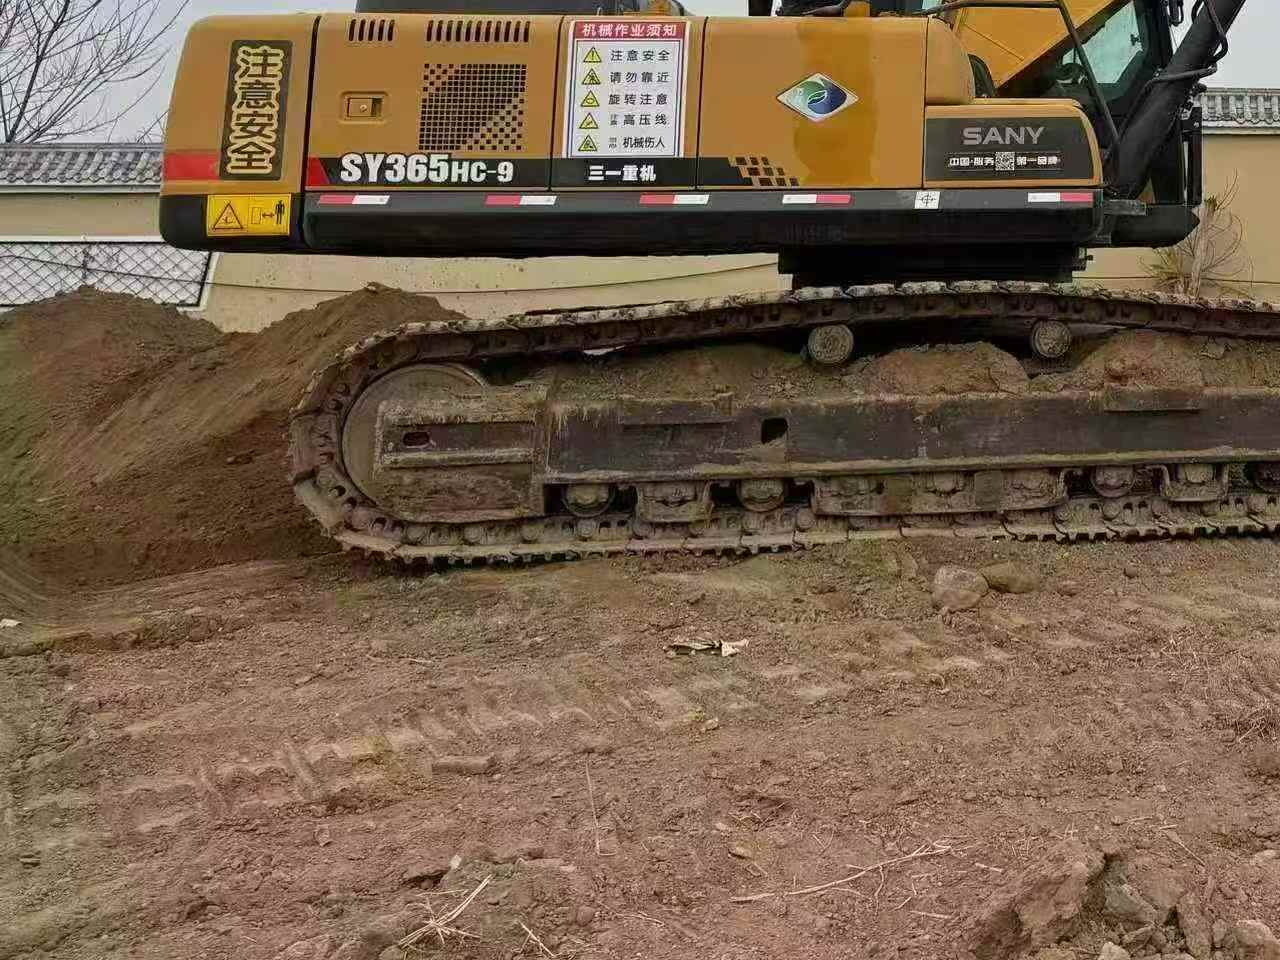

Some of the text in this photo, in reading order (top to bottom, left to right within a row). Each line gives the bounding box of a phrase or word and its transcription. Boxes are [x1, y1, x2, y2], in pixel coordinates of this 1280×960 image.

[582, 23, 677, 37] 机械作业须知
[610, 49, 671, 62] 注意安全
[609, 71, 669, 83] 请勿靠近
[608, 93, 668, 106] 旋转注意
[227, 46, 284, 174] 注意安全
[963, 126, 1045, 145] SANY
[340, 153, 514, 183] SY365HC-9
[588, 164, 657, 182] 三一重机
